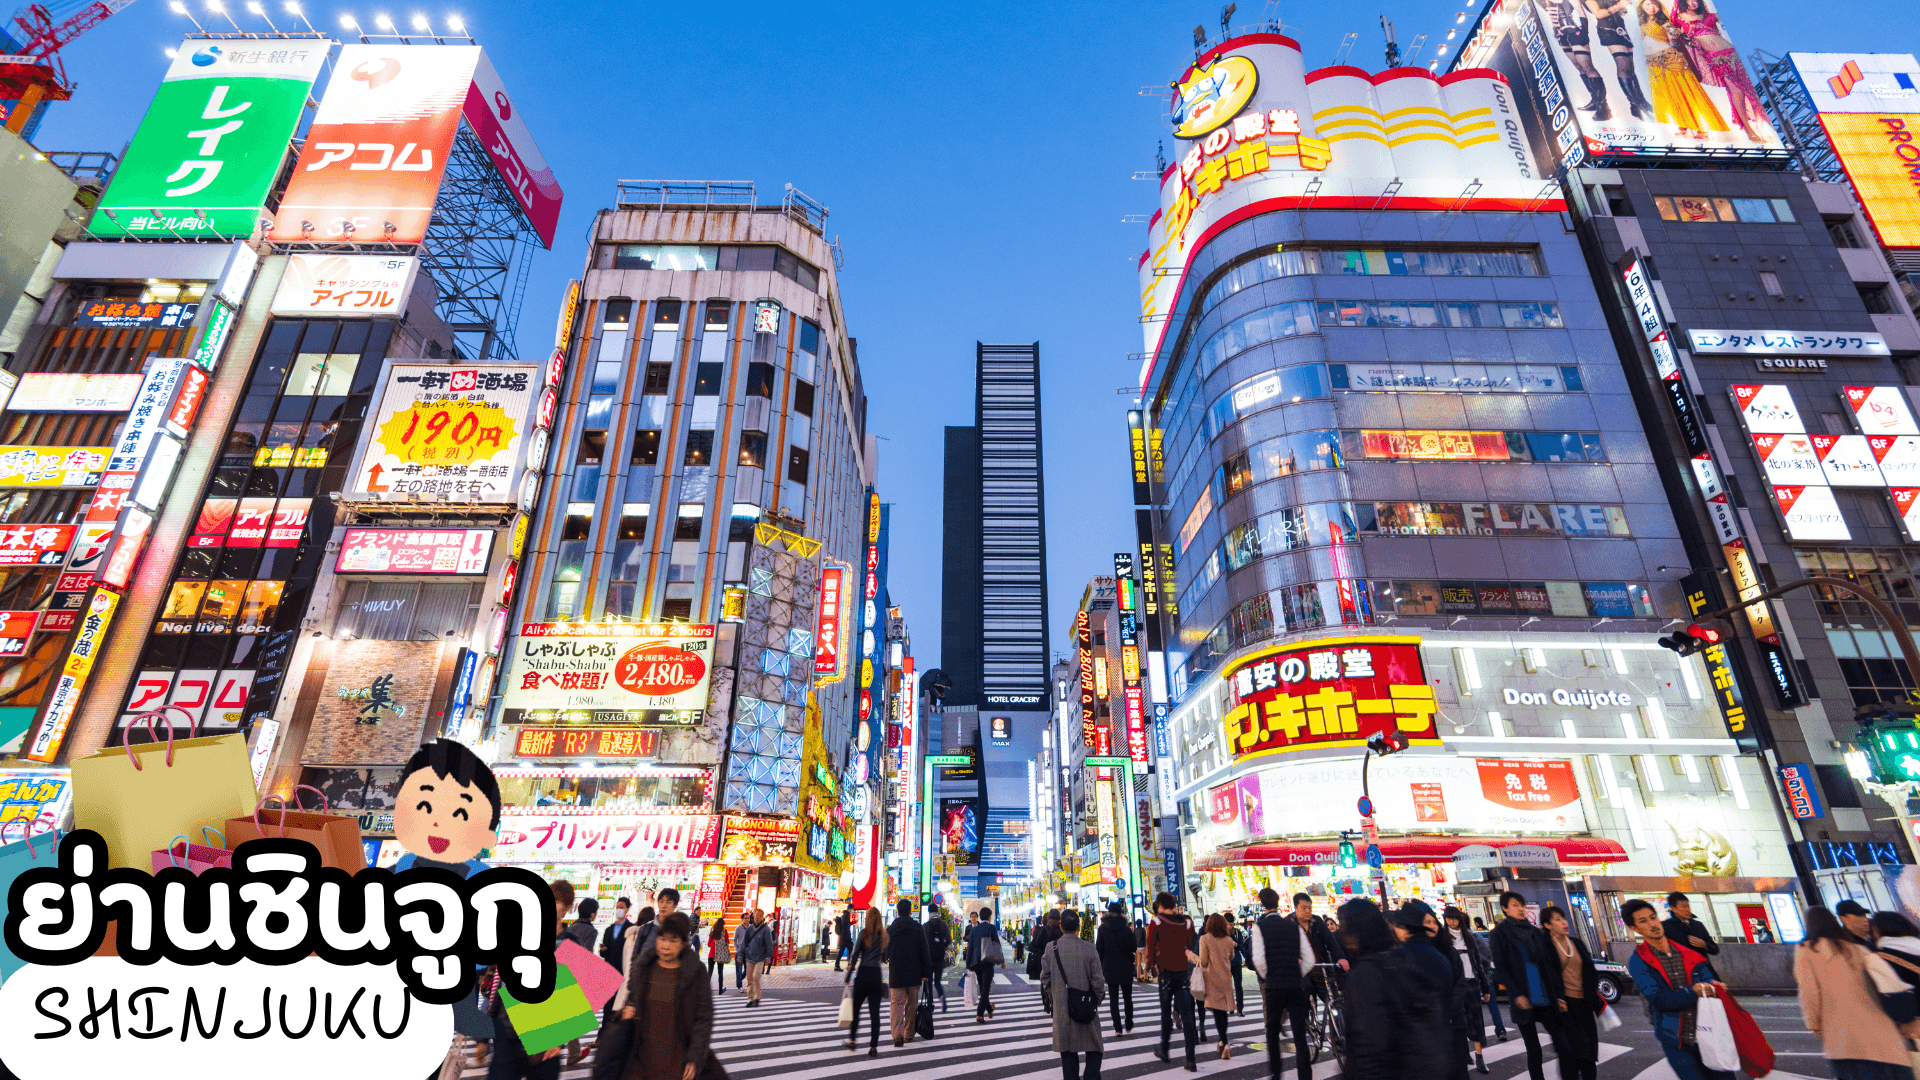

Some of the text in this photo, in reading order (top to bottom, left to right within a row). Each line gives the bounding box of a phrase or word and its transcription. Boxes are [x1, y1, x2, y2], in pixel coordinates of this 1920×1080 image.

[228, 50, 308, 64] 新生銀行
[165, 85, 252, 197] レイク
[1504, 120, 1530, 178] Quijote
[306, 142, 433, 172] アコム
[491, 130, 533, 209] アコム
[127, 216, 215, 231] 当ビル向い
[387, 261, 405, 269] 5F
[310, 290, 395, 308] アイフル
[1630, 272, 1658, 332] 6年4組
[1698, 335, 1881, 349] エンタメ レストランタワー
[1763, 359, 1828, 369] SQUARE
[397, 370, 528, 391] 一軒め酒場
[1737, 388, 1753, 398] 8F
[1848, 389, 1865, 399] 9F
[173, 381, 200, 425] アイフル
[121, 371, 167, 453] お好み焼き本陣
[401, 410, 503, 447] 190円
[1757, 437, 1774, 447] 4F
[1814, 437, 1831, 448] 5F
[1871, 439, 1887, 449] 6F
[1132, 428, 1147, 483] 驚安の殿堂
[1768, 459, 1819, 470] 北の家族
[393, 479, 496, 493] 左の路地を右へ
[1895, 490, 1912, 500] 2F
[237, 509, 307, 526] アイフル
[1462, 503, 1606, 530] FLARE
[1380, 526, 1494, 536] PHOTO STUDIO
[350, 532, 463, 545] ブランド高価買取
[40, 551, 62, 563] 4F
[112, 539, 135, 574] アコム
[438, 550, 456, 558] TAX
[435, 559, 455, 567] FREE
[464, 559, 482, 569] 1F
[1443, 588, 1473, 602] 販売
[1480, 592, 1510, 600] ブランド
[196, 623, 224, 632] live
[525, 625, 611, 636] All-you-can-eat
[650, 625, 666, 635] for
[669, 625, 677, 635] 2
[73, 614, 102, 657] 金の蔵
[5, 639, 23, 652] 4F
[525, 641, 618, 657] しゃぶしゃぶ
[71, 659, 86, 670] 2F
[623, 663, 682, 688] 2,480
[1236, 649, 1375, 697] 驚安の殿堂
[129, 679, 247, 709] アコム
[1503, 688, 1631, 709] Don Quijote
[32, 677, 73, 753] 東京チカラめし
[679, 711, 702, 723] 5F
[519, 731, 557, 754] 最新作
[1505, 773, 1547, 790] 免税
[1507, 791, 1550, 801] Tax Free
[728, 819, 800, 832] OKONOMI YAKI
[1138, 799, 1153, 851] カラオケ
[702, 817, 718, 858] コスチューム
[1289, 853, 1311, 862] Don
[1167, 851, 1177, 892] カラオケ
